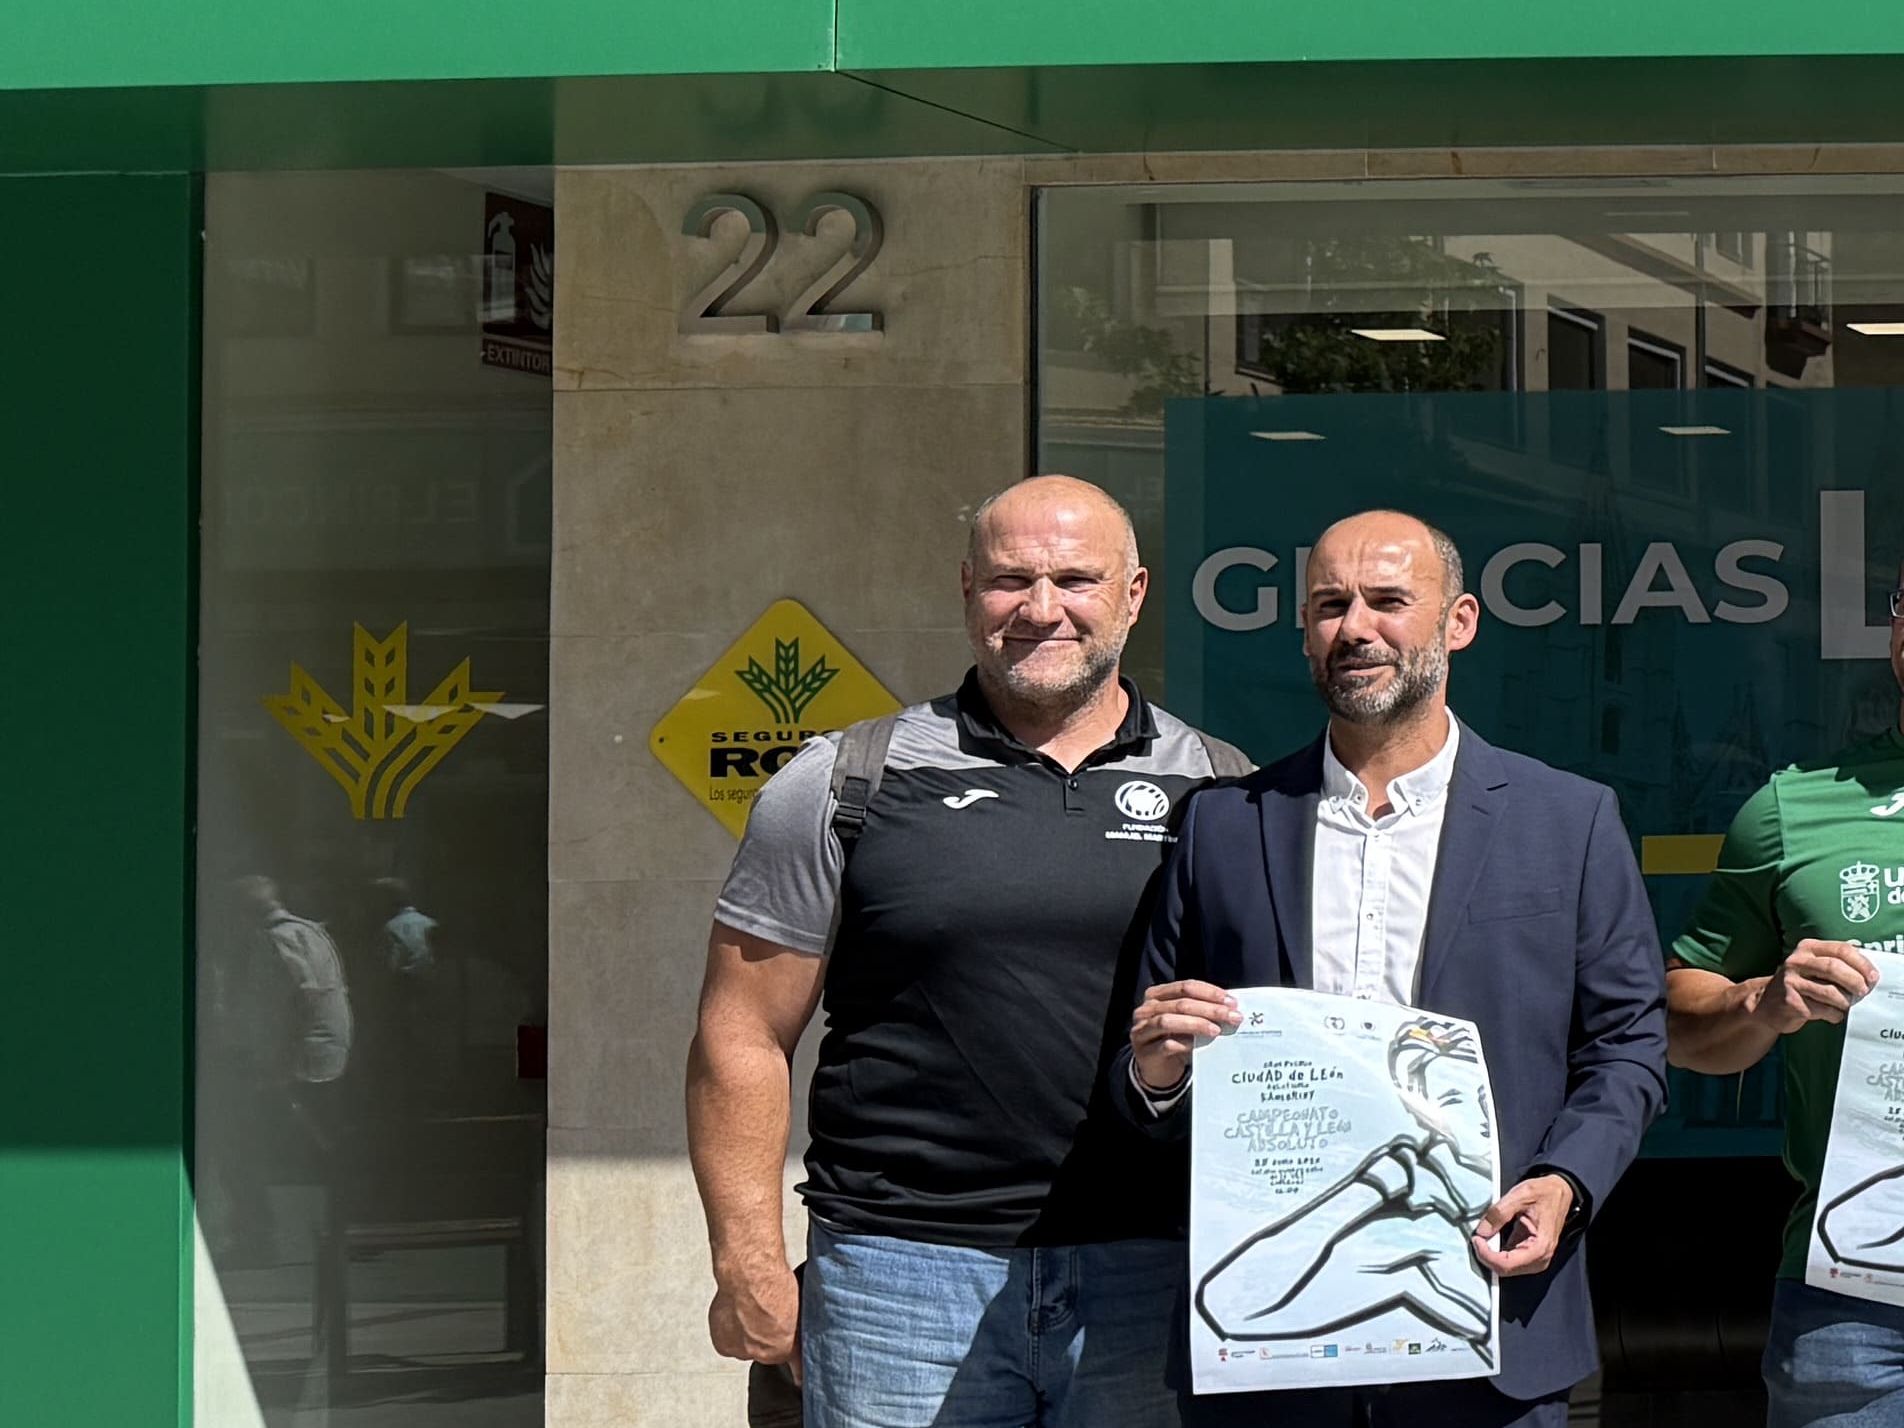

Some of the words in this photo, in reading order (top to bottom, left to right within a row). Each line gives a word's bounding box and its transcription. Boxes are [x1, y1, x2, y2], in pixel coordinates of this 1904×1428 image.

[678, 192, 886, 335] 22
[1191, 539, 1790, 633] GCIAS
[711, 729, 838, 742] SEGUR
